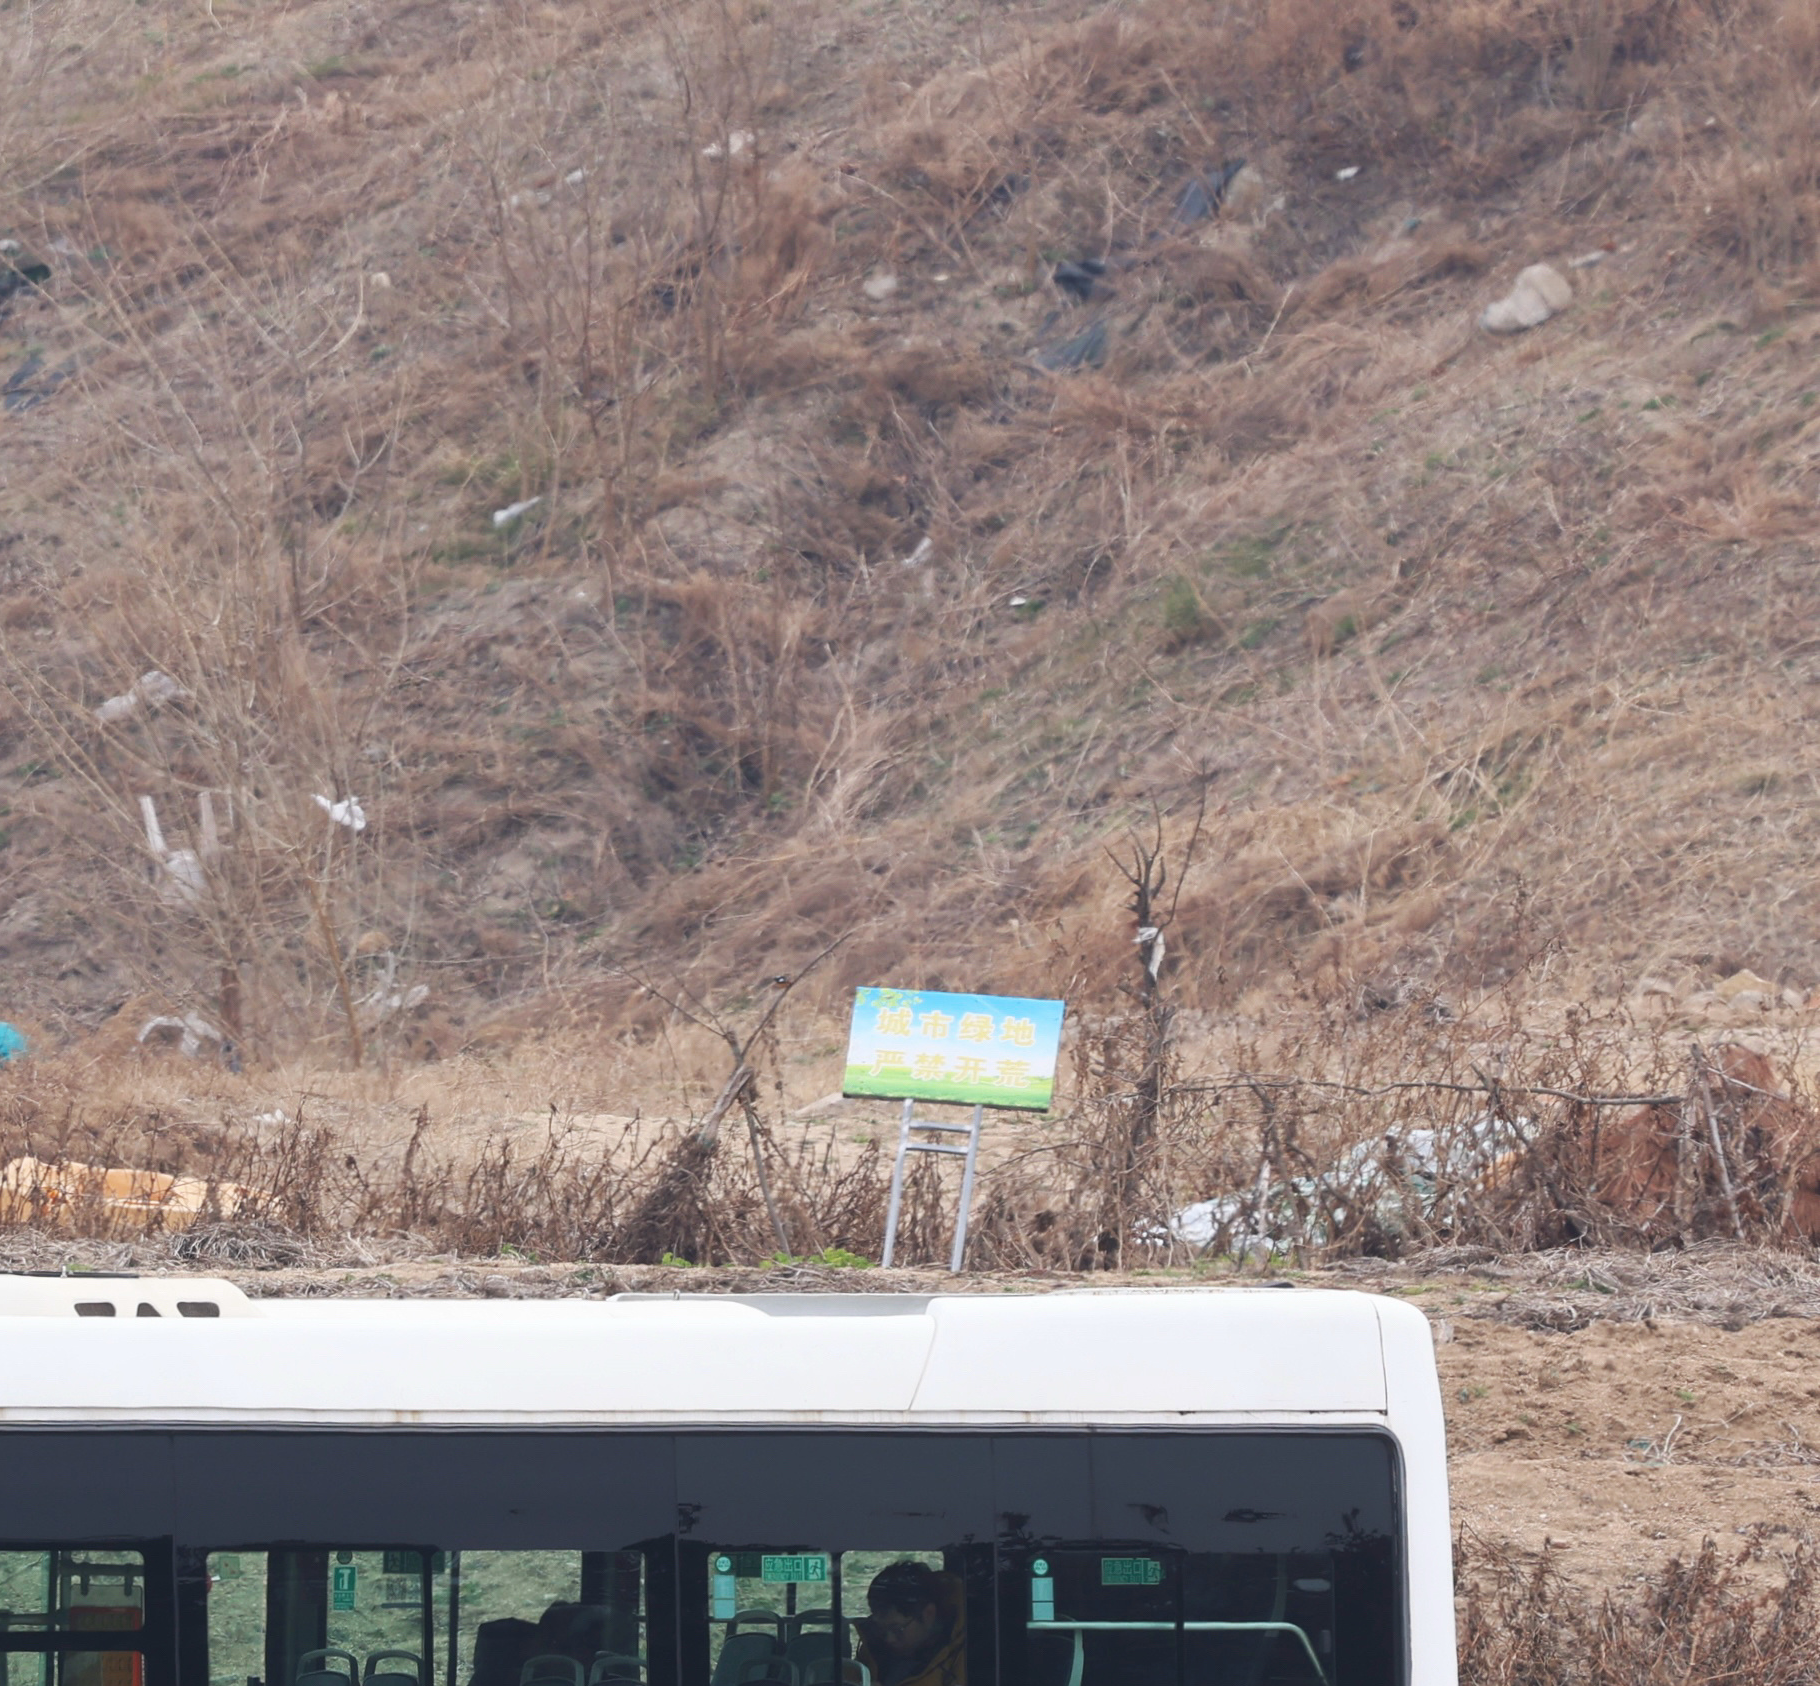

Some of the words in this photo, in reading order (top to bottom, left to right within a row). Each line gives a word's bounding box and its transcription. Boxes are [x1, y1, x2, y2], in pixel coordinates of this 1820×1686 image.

[876, 1007, 1036, 1047] 城市绿地
[869, 1049, 1032, 1089] 严禁开荒
